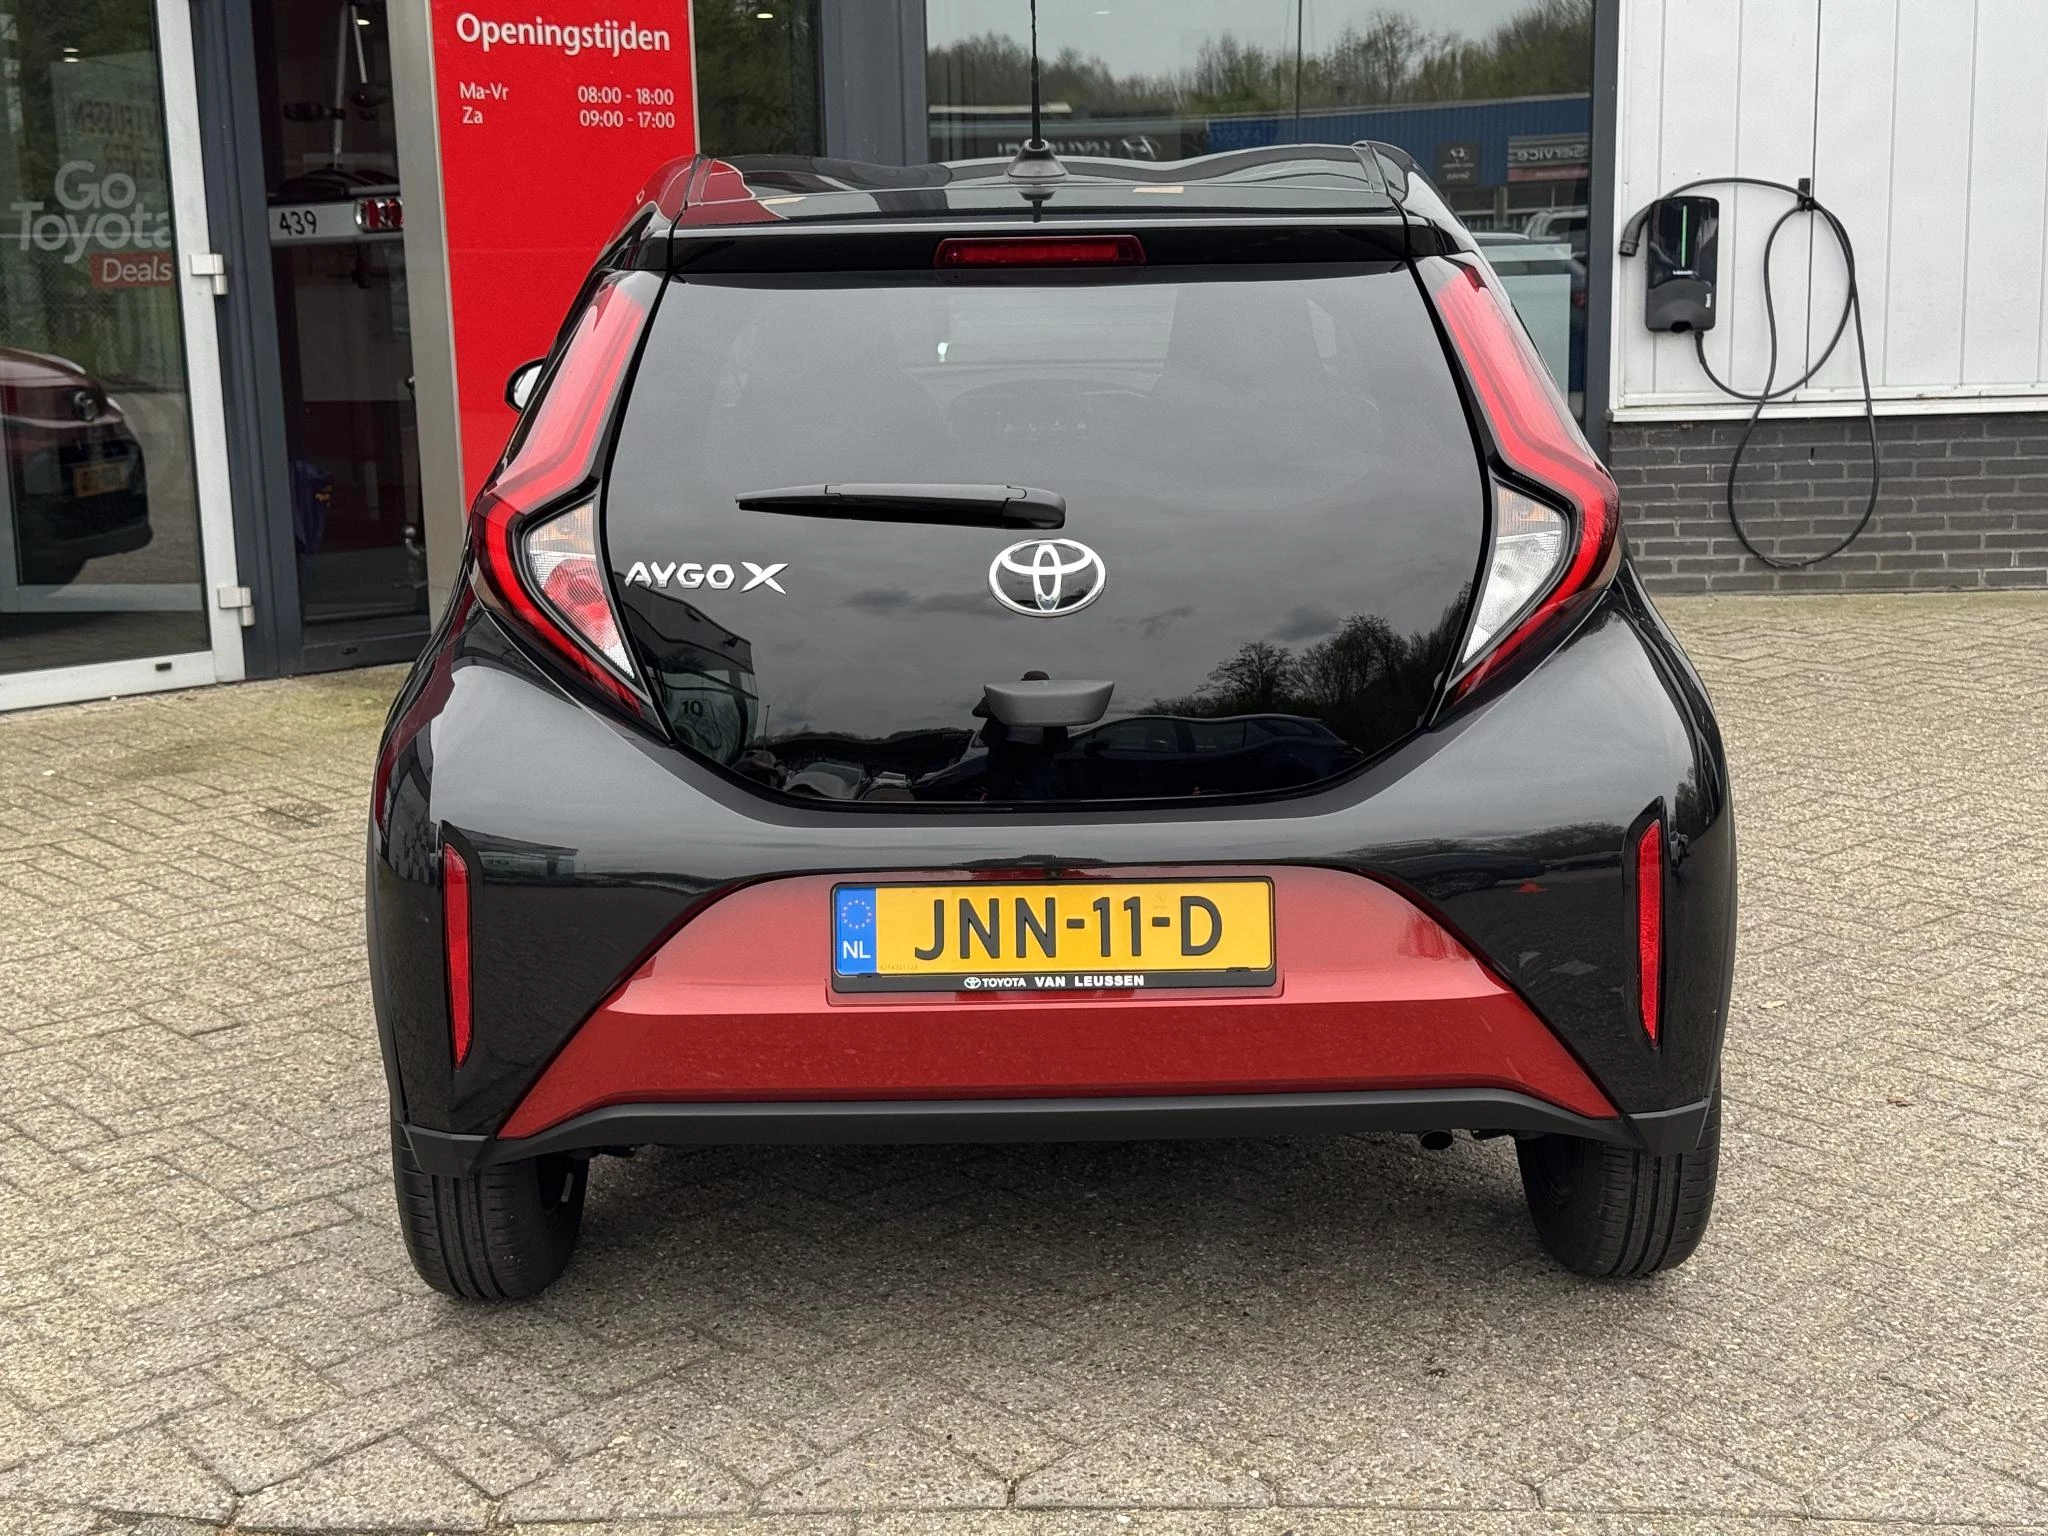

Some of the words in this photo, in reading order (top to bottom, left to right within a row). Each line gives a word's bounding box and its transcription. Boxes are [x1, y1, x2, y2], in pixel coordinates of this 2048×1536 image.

[456, 12, 671, 58] Openingstijden
[459, 81, 509, 101] Ma-Vr
[577, 85, 622, 104] 08:00
[635, 88, 674, 106] 18:00
[462, 106, 484, 124] Za
[579, 109, 624, 128] 09:00
[637, 111, 676, 129] 17:00
[54, 160, 137, 211] Go
[279, 210, 318, 236] 439
[102, 256, 173, 283] Deals
[624, 561, 735, 590] AYGO
[740, 561, 789, 595] X
[914, 895, 1223, 961] JNN-11-D
[842, 940, 871, 960] NL
[981, 977, 1027, 989] TOYOTA
[1035, 976, 1067, 988] VAN
[1074, 974, 1145, 988] LEUSSEN
